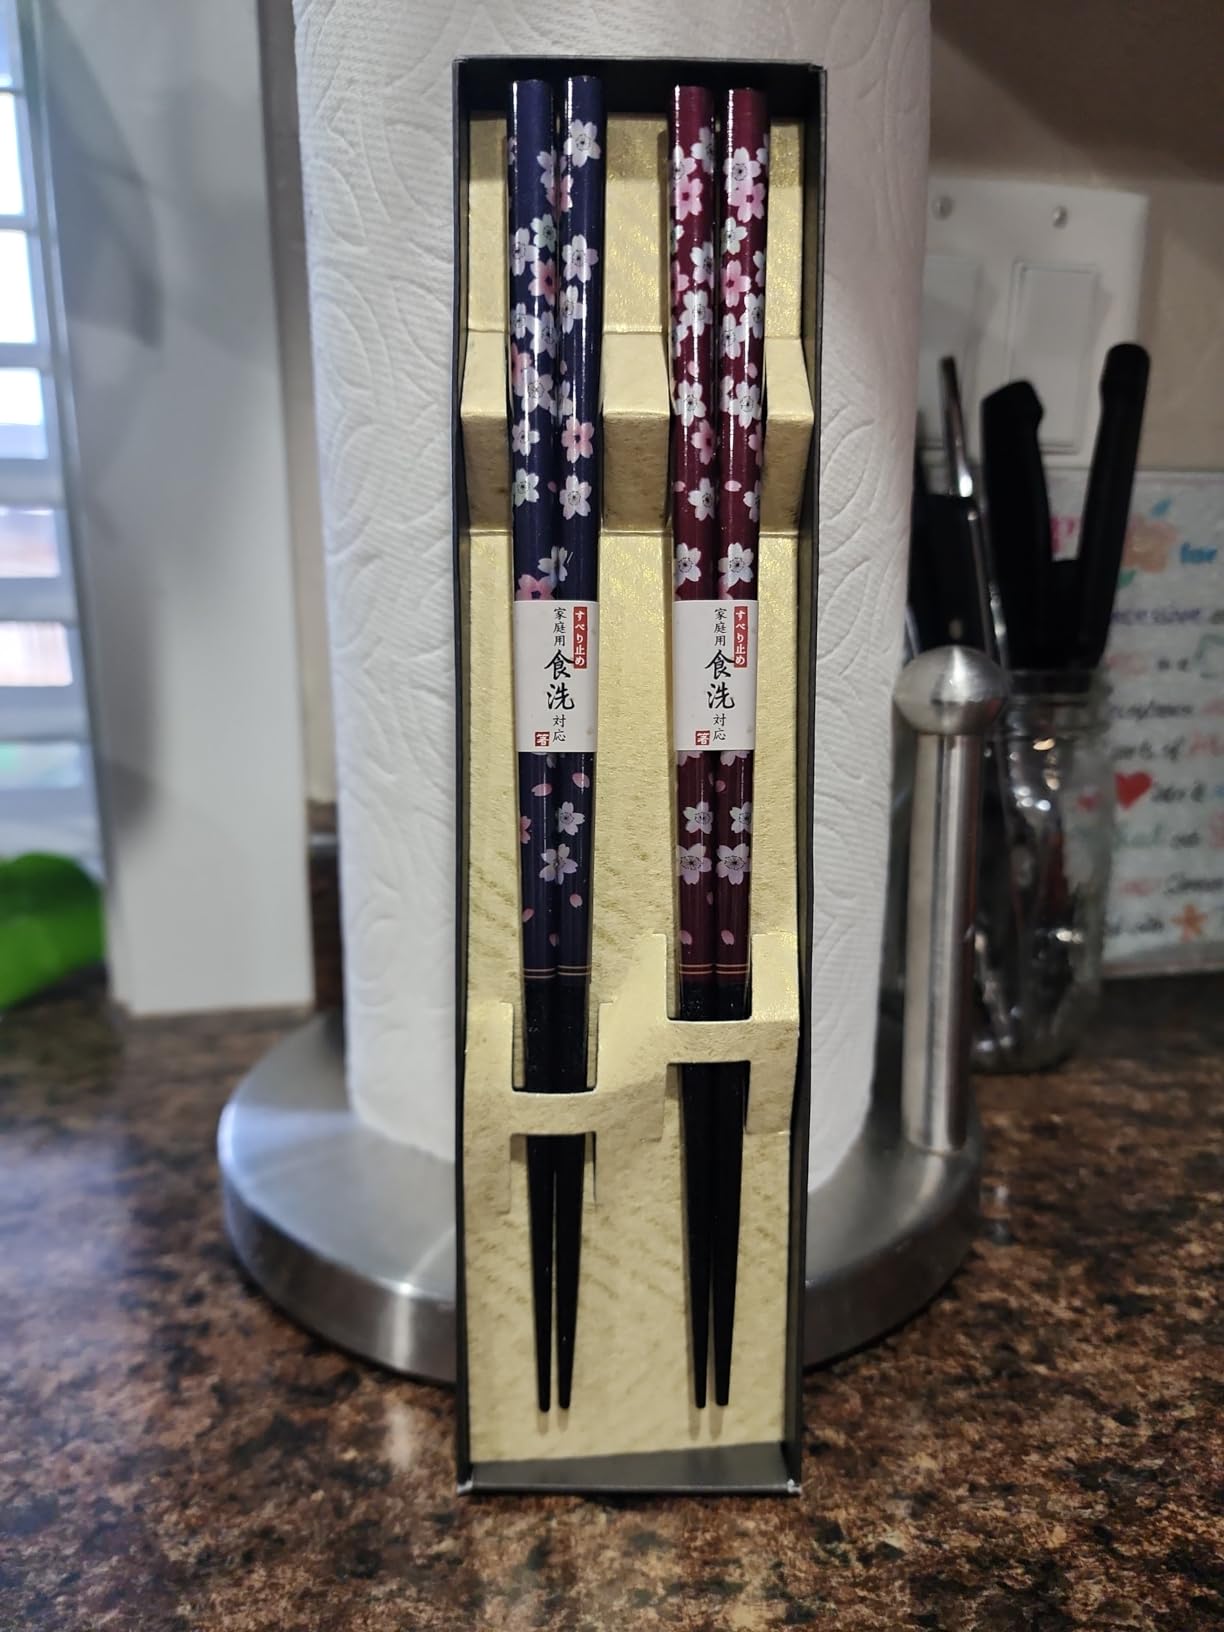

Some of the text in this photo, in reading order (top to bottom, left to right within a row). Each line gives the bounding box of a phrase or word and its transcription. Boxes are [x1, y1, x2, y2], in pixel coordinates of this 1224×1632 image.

[574, 608, 586, 667] すべり止め
[735, 608, 747, 667] すべり止め
